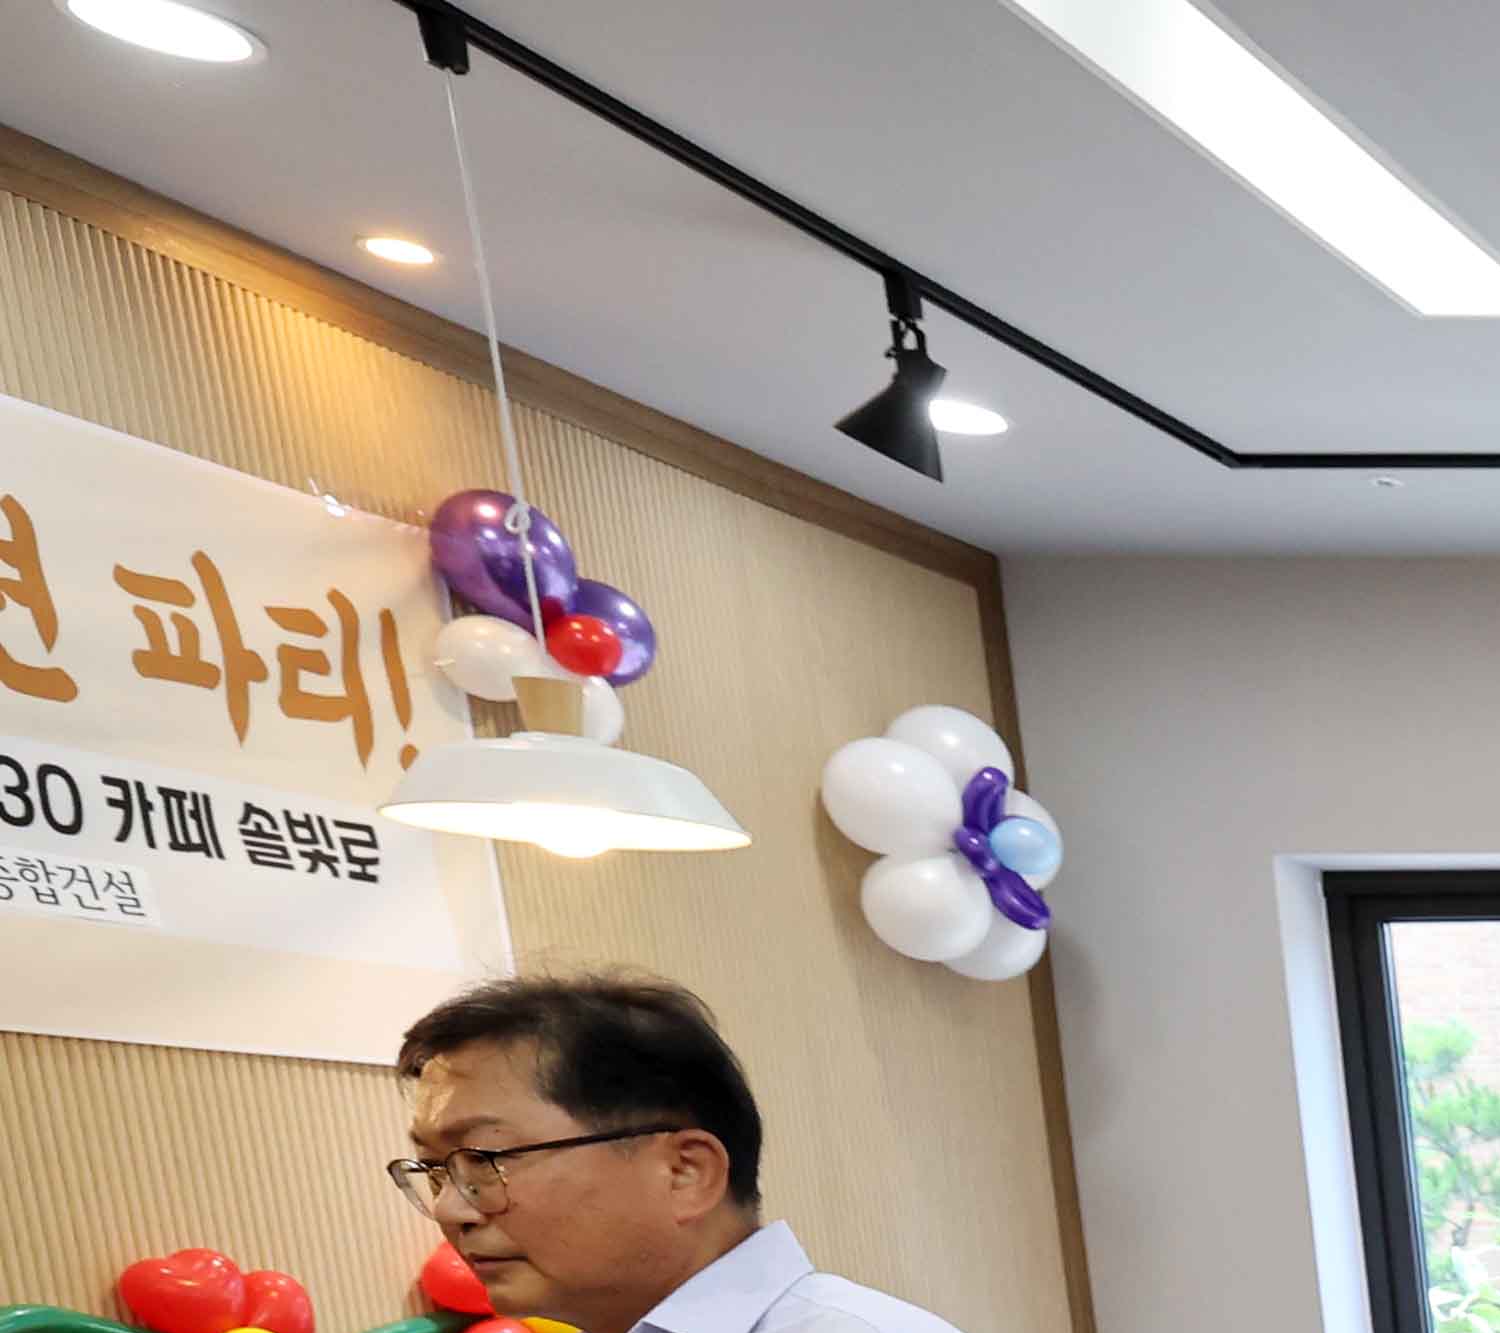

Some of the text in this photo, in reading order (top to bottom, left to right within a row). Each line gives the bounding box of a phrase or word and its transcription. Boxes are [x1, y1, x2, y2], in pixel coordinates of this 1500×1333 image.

[113, 549, 419, 772] 파티!
[100, 774, 226, 860] 카페
[238, 802, 380, 883] 솔빛로
